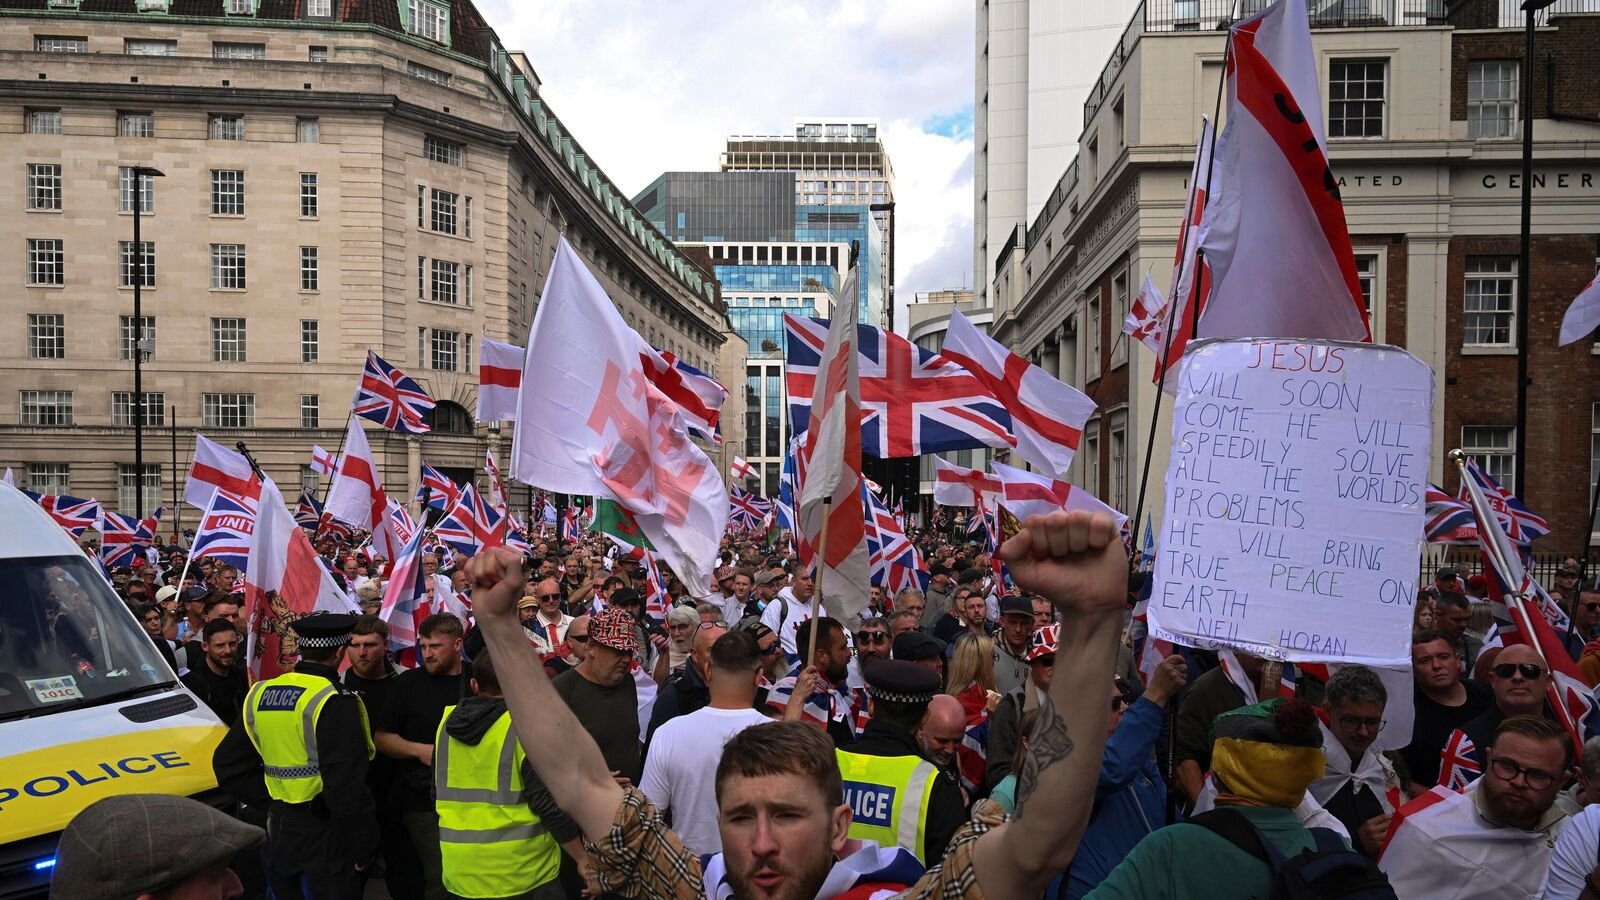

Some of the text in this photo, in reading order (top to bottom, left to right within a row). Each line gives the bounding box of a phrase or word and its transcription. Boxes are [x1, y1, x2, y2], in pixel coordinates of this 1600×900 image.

[1247, 341, 1345, 373] JESUS
[1188, 371, 1362, 413] WILL SOON
[1184, 401, 1410, 449] COME. HE WILL
[1177, 431, 1414, 478] SPEEDILY SOLVE
[1175, 456, 1420, 505] ALL THE WORLD'S
[215, 516, 255, 532] UNIT
[1172, 487, 1305, 530] PROBLEMS.
[1169, 523, 1385, 571] HE WILL BRING
[1166, 550, 1414, 605] TRUE PEACE ON
[1162, 581, 1249, 619] EARTH
[1197, 617, 1347, 657] NEIL HORAN
[41, 688, 75, 699] 101C
[260, 689, 301, 706] POLICE
[842, 788, 890, 820] LICE
